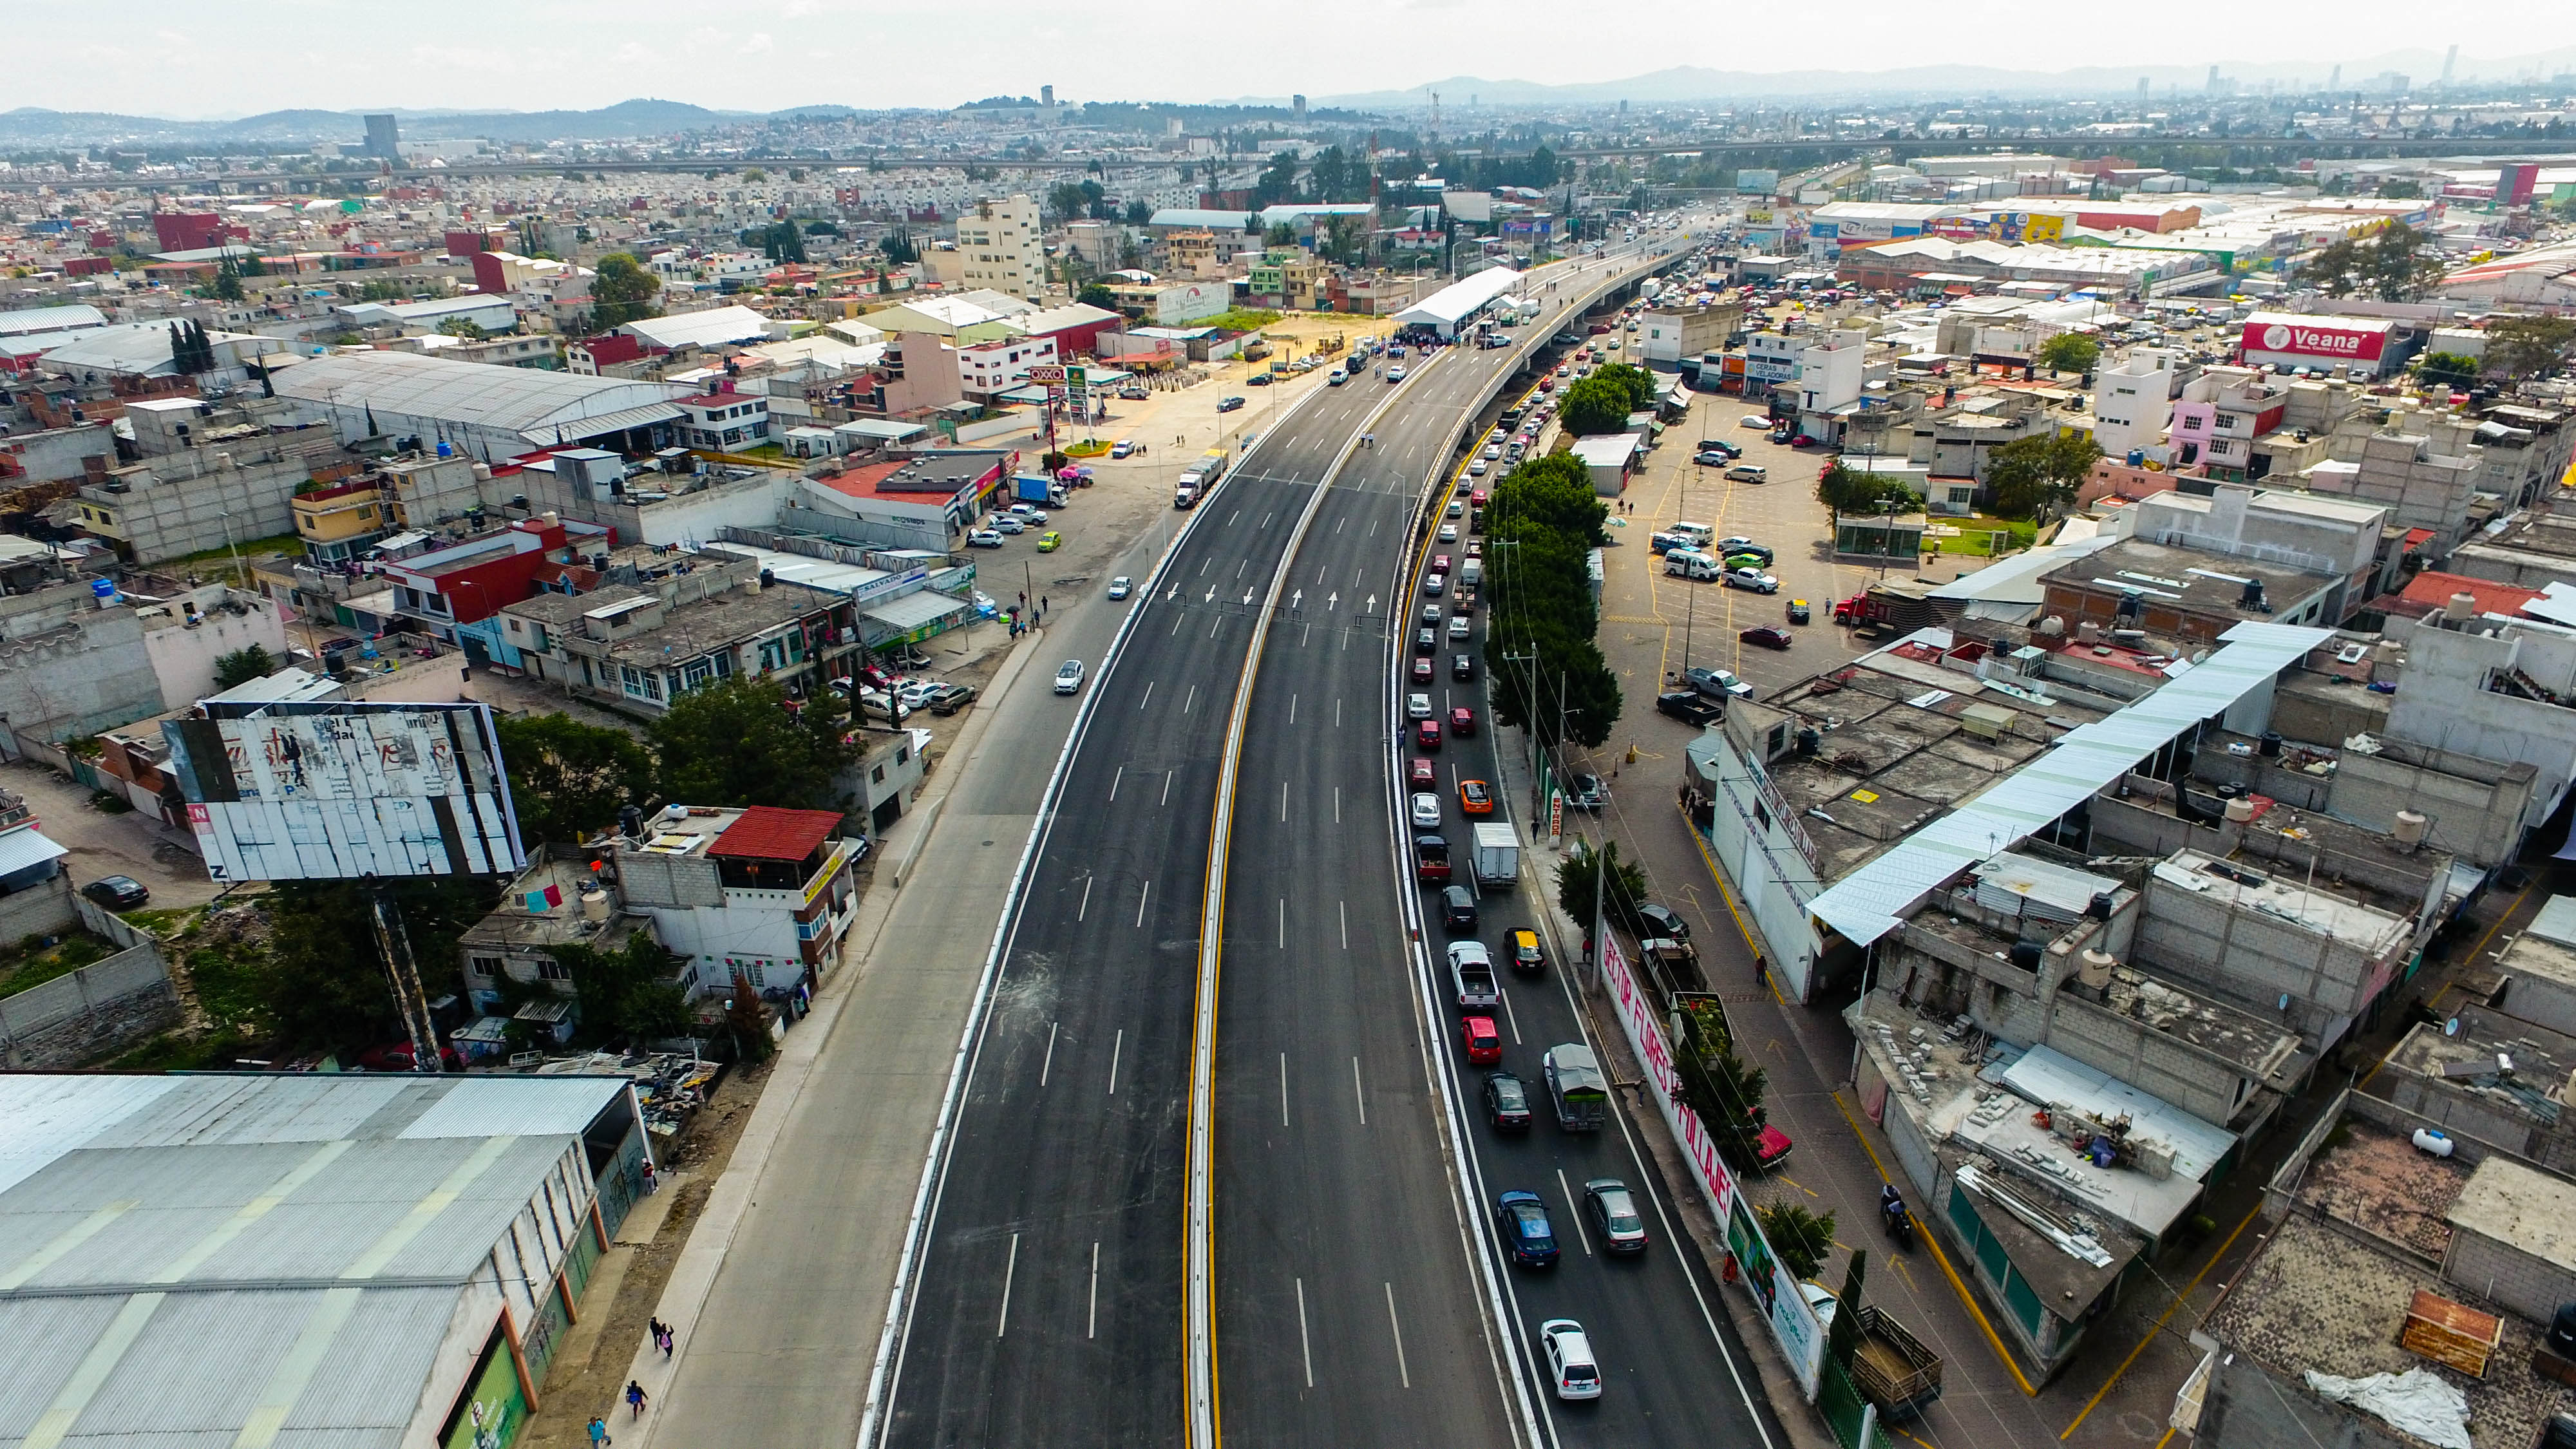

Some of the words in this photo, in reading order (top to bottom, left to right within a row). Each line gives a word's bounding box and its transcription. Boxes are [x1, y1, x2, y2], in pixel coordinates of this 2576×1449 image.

[2295, 329, 2359, 349] Veana
[1031, 370, 1062, 379] OXXO
[1756, 370, 1791, 380] VELADORAS
[864, 574, 902, 591] SALVADO
[1552, 797, 1560, 835] ENTRADA
[1604, 932, 1632, 1016] SECTOR
[1633, 996, 1669, 1093] FLORES
